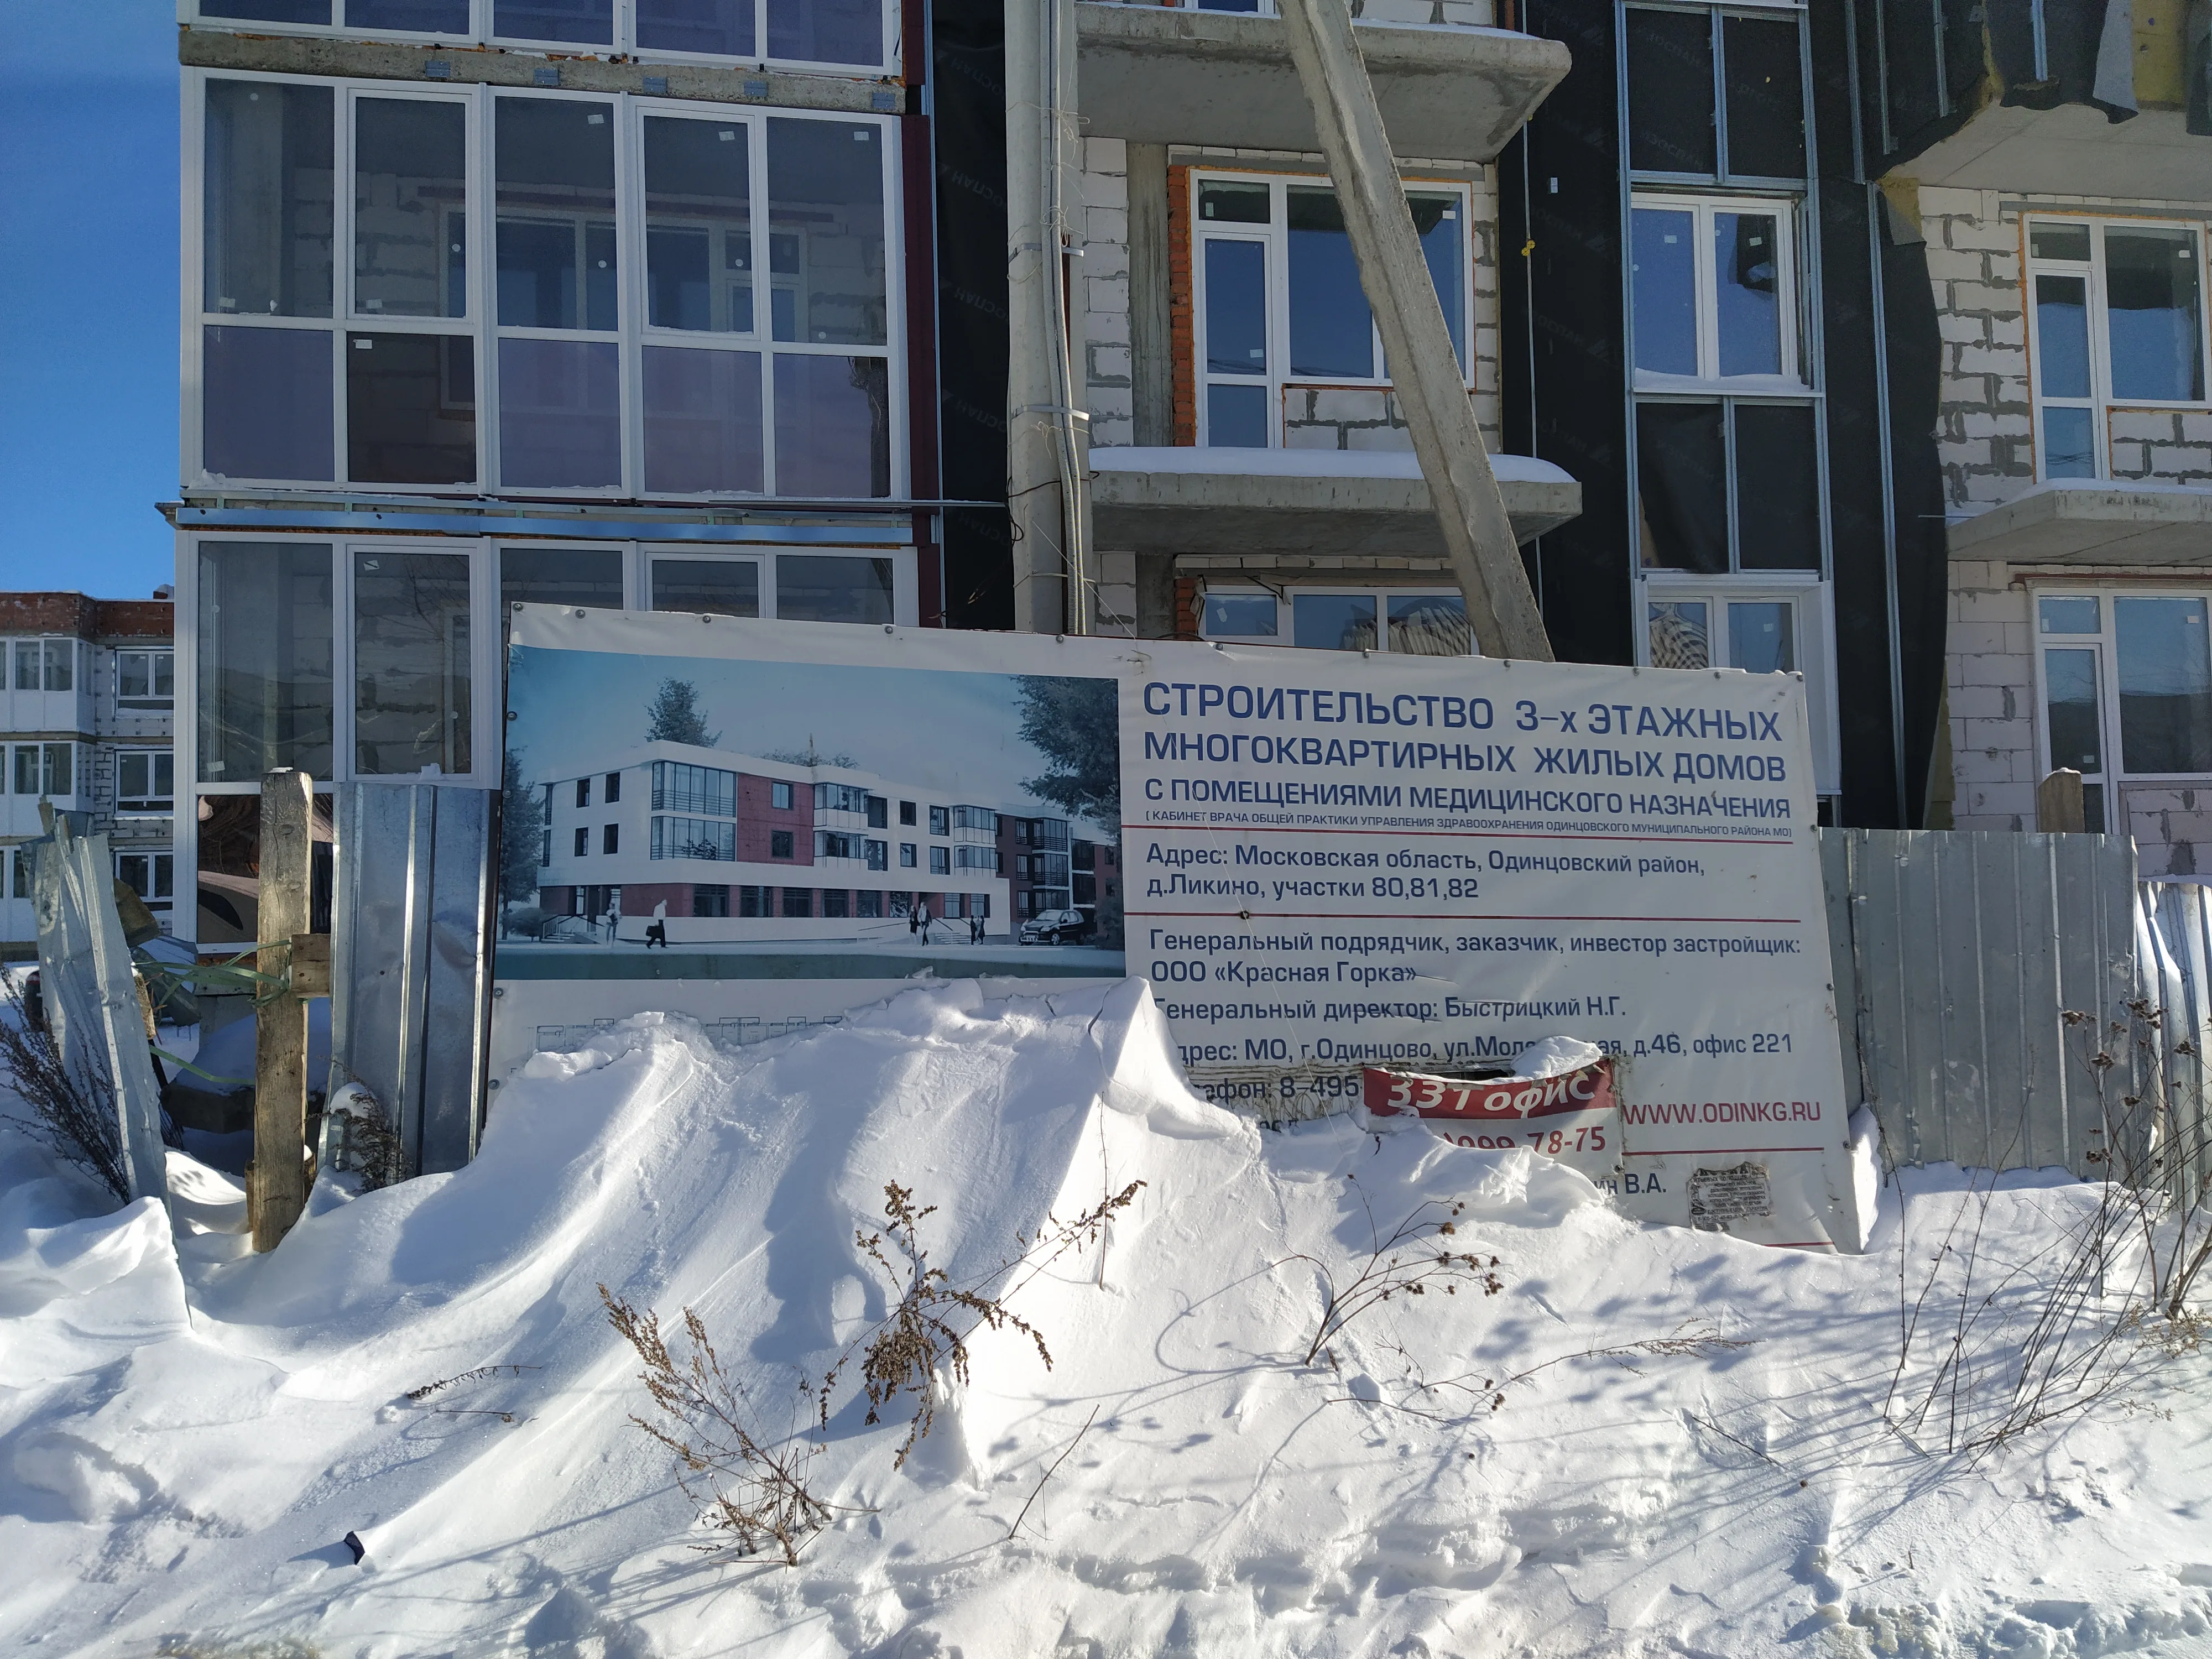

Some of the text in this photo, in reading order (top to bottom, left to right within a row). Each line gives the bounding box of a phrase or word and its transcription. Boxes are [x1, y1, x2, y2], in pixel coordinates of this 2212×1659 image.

[1144, 682, 1493, 729] СТРОИТЕЛЬСТВО
[1589, 704, 1782, 741] ЭТАЖНЫХ
[1145, 732, 1786, 784] МНОГОКВАРТИРНЫХ ЖИЛЫХ ДОМОВ
[1145, 779, 1790, 818] С ПОМЕЩЕНИЯМИ МЕДИЦИНСКОГО НАЗНАЧЕНИЯ
[1153, 811, 1207, 821] КАБИНЕТ
[1211, 812, 1249, 822] ВРАЧА
[1252, 812, 1293, 825] ОБЩЕЙ
[1297, 815, 1358, 825] ПРАКТИКИ
[1361, 817, 1434, 827] УПРАВЛЕНИЯ
[1437, 819, 1543, 830] ЗДРАВООХРАНЕНИЯ
[1547, 822, 1629, 832] ОДИНЦОВСКОГО
[1632, 824, 1729, 834] МУНИЦИПАЛЬНОГО
[1731, 826, 1771, 836] РАЙОНА
[1773, 828, 1791, 837] МО)
[1146, 843, 1704, 877] Адрес: Московская область, Одинцовский район,
[1147, 874, 1478, 901] д.Ликино, участки 80,81,82
[1151, 929, 1800, 957] Генеральный подрядчик, заказчик, инвестор застройщик:
[1152, 961, 1416, 987] ООО «Красная Горка»
[1324, 1002, 1438, 1024] директор:
[1445, 997, 1580, 1022] Быстрицкий
[1587, 997, 1625, 1015] Н.Г.
[1178, 1045, 1238, 1067] дрес:
[1245, 1039, 1293, 1064] МО,
[1301, 1039, 1437, 1064] г.Одинцово,
[1634, 1032, 1686, 1057] д.46,
[1693, 1034, 1746, 1058] офис
[1752, 1034, 1791, 1052] 221
[1625, 1102, 1820, 1125] WWW.ODINKG.RU
[1624, 1173, 1666, 1194] В.А.
